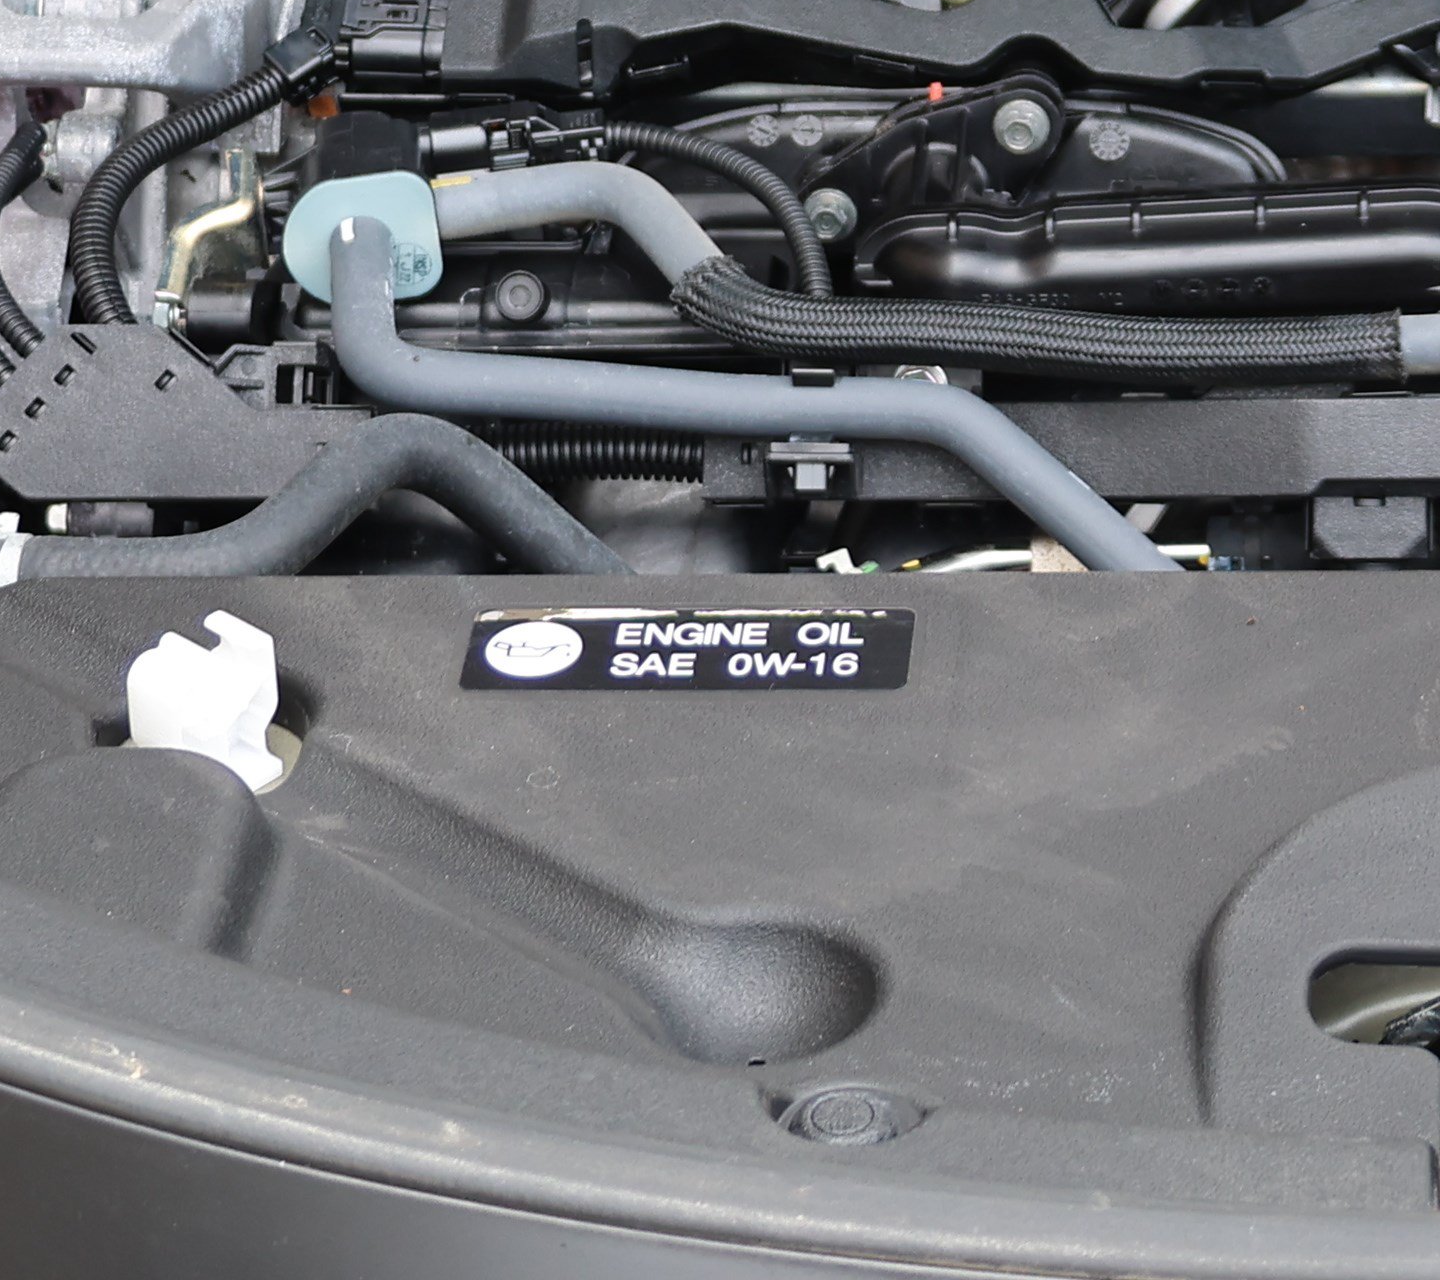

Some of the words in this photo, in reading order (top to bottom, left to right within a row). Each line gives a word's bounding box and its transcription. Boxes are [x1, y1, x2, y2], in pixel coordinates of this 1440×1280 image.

[616, 622, 769, 646] ENGINE
[797, 622, 864, 646] OIL
[610, 652, 696, 677] SAE
[727, 652, 859, 677] 0W-16
